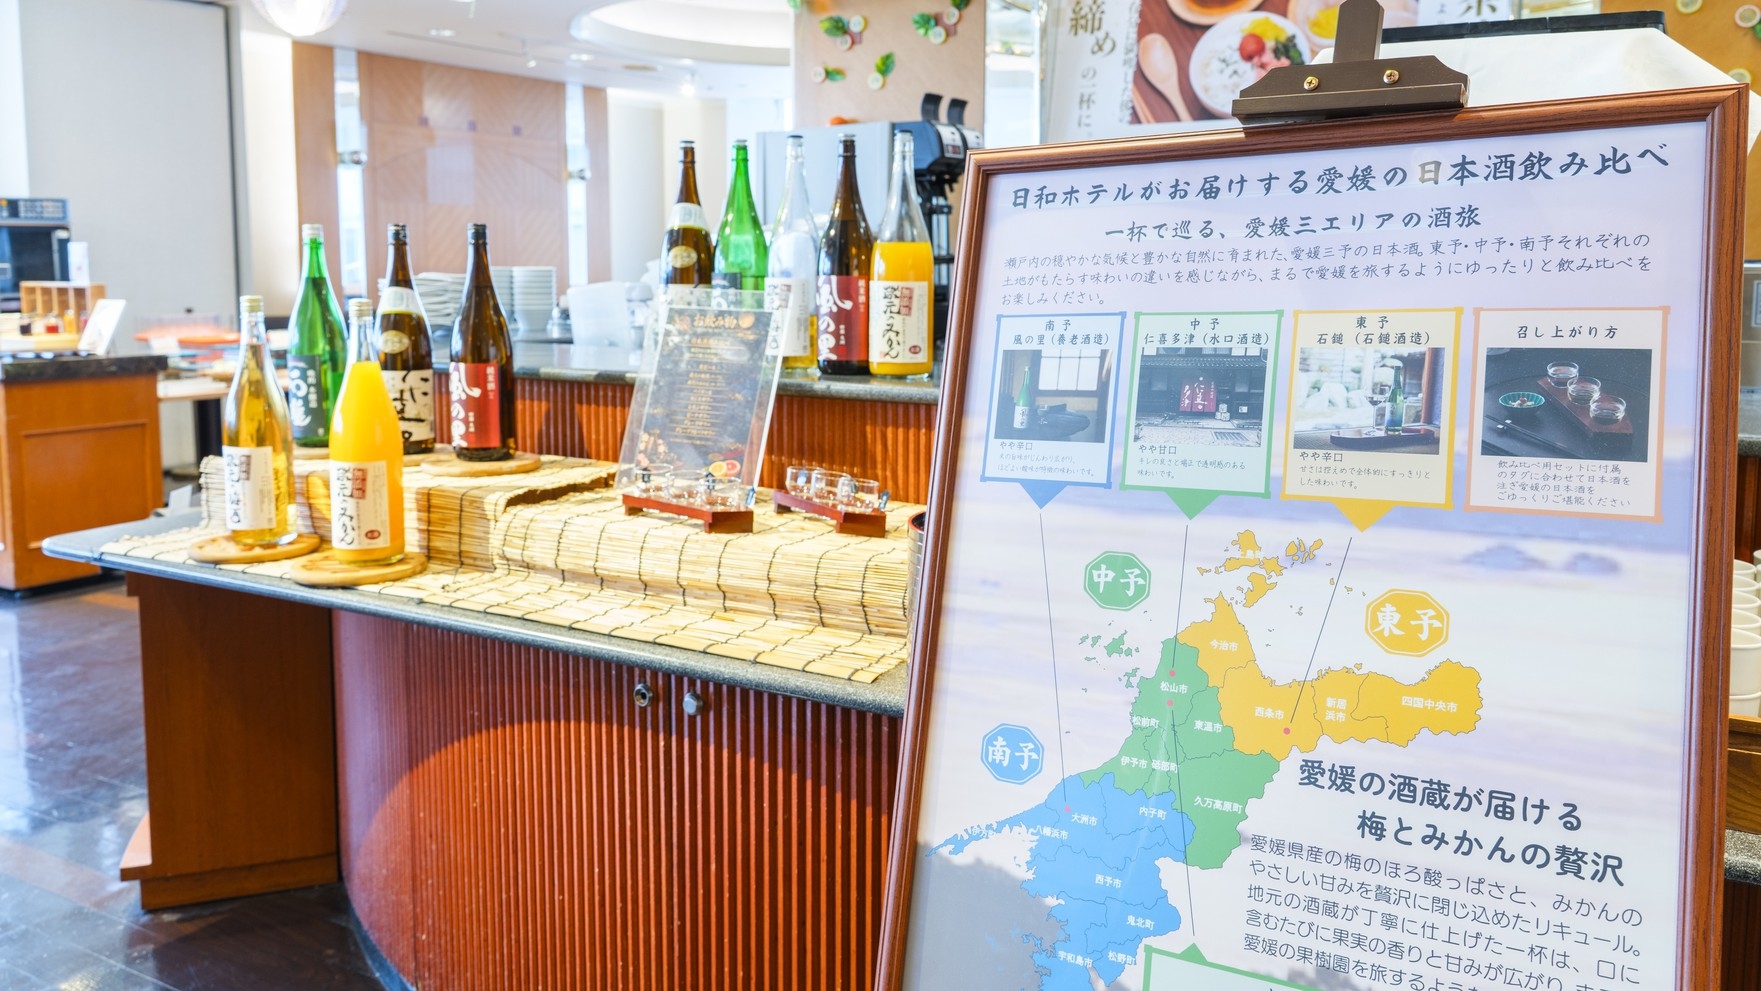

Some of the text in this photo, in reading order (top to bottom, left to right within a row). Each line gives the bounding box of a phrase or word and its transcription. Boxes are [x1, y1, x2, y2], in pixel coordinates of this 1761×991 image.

[1012, 143, 1670, 209] 日和ホテルがお届けする愛媛の日本酒飲み比べ
[1105, 204, 1482, 242] 一杯で巡る、愛媛三エリアの酒旅
[1001, 256, 1652, 288] 土地がもたらす味わいの違いを感じながら、まるで愛媛を旅するようにゆったりと飲み比べを
[1001, 292, 1105, 306] お楽しみください。
[1045, 319, 1072, 332] 南予
[1190, 318, 1220, 330] 中予
[1356, 315, 1389, 329] 東予
[1013, 334, 1110, 346] 風の里（養老酒造）
[1144, 333, 1270, 346] 仁喜多津（水口酒造）
[1316, 331, 1431, 346] 石鎚（石鎚酒造）
[1517, 325, 1619, 340] 召し上がり方
[1000, 441, 1033, 451] やや辛口
[1139, 445, 1177, 455] やや甘口
[1299, 452, 1343, 462] やや辛口
[1299, 466, 1431, 479] 甘さは控えめで全体的にすっきりと
[1498, 461, 1621, 474] 飲み比べ用セットに付属
[1300, 478, 1358, 490] した味わいです。
[1497, 471, 1631, 486] のタグに合わせて日本酒を
[1496, 481, 1595, 495] 注ぎ愛媛の日本酒を
[1497, 491, 1631, 507] ごゆっくりご堪能ください
[1092, 563, 1146, 596] 中予
[1372, 603, 1443, 641] 東予
[1209, 639, 1238, 652] 今治市
[1160, 680, 1188, 694] 松山市
[1401, 695, 1458, 713] 四国中央市
[1254, 706, 1285, 720] 西条市
[1325, 710, 1346, 723] 浜市
[1132, 715, 1160, 728] 松前町
[1194, 719, 1223, 733] 東温市
[988, 736, 1039, 770] 南予
[1120, 758, 1148, 771] 伊予市
[1298, 758, 1583, 832] 愛媛の酒蔵が届ける
[1194, 796, 1244, 814] 久万高原町
[1071, 813, 1098, 826] 大洲市
[1139, 806, 1167, 820] 内子町
[1035, 825, 1069, 840] 八幡浜市
[1356, 809, 1625, 888] 梅とみかんの贅沢
[1095, 873, 1122, 888] 西予市
[1250, 833, 1643, 929] 愛媛県産の梅のほろ酸っぱさと、みかんの
[1249, 859, 1642, 957] やさしい甘みを贅沢に閉じ込めたリキュール。
[1126, 915, 1155, 930] 鬼北町
[1247, 884, 1640, 985] 地元の酒蔵が丁寧に仕上げた一杯は、口に
[1245, 908, 1612, 991] 含むたびに果実の香りと甘みが広がり
[1057, 950, 1093, 968] 宇和島市
[1108, 950, 1136, 966] 松野町
